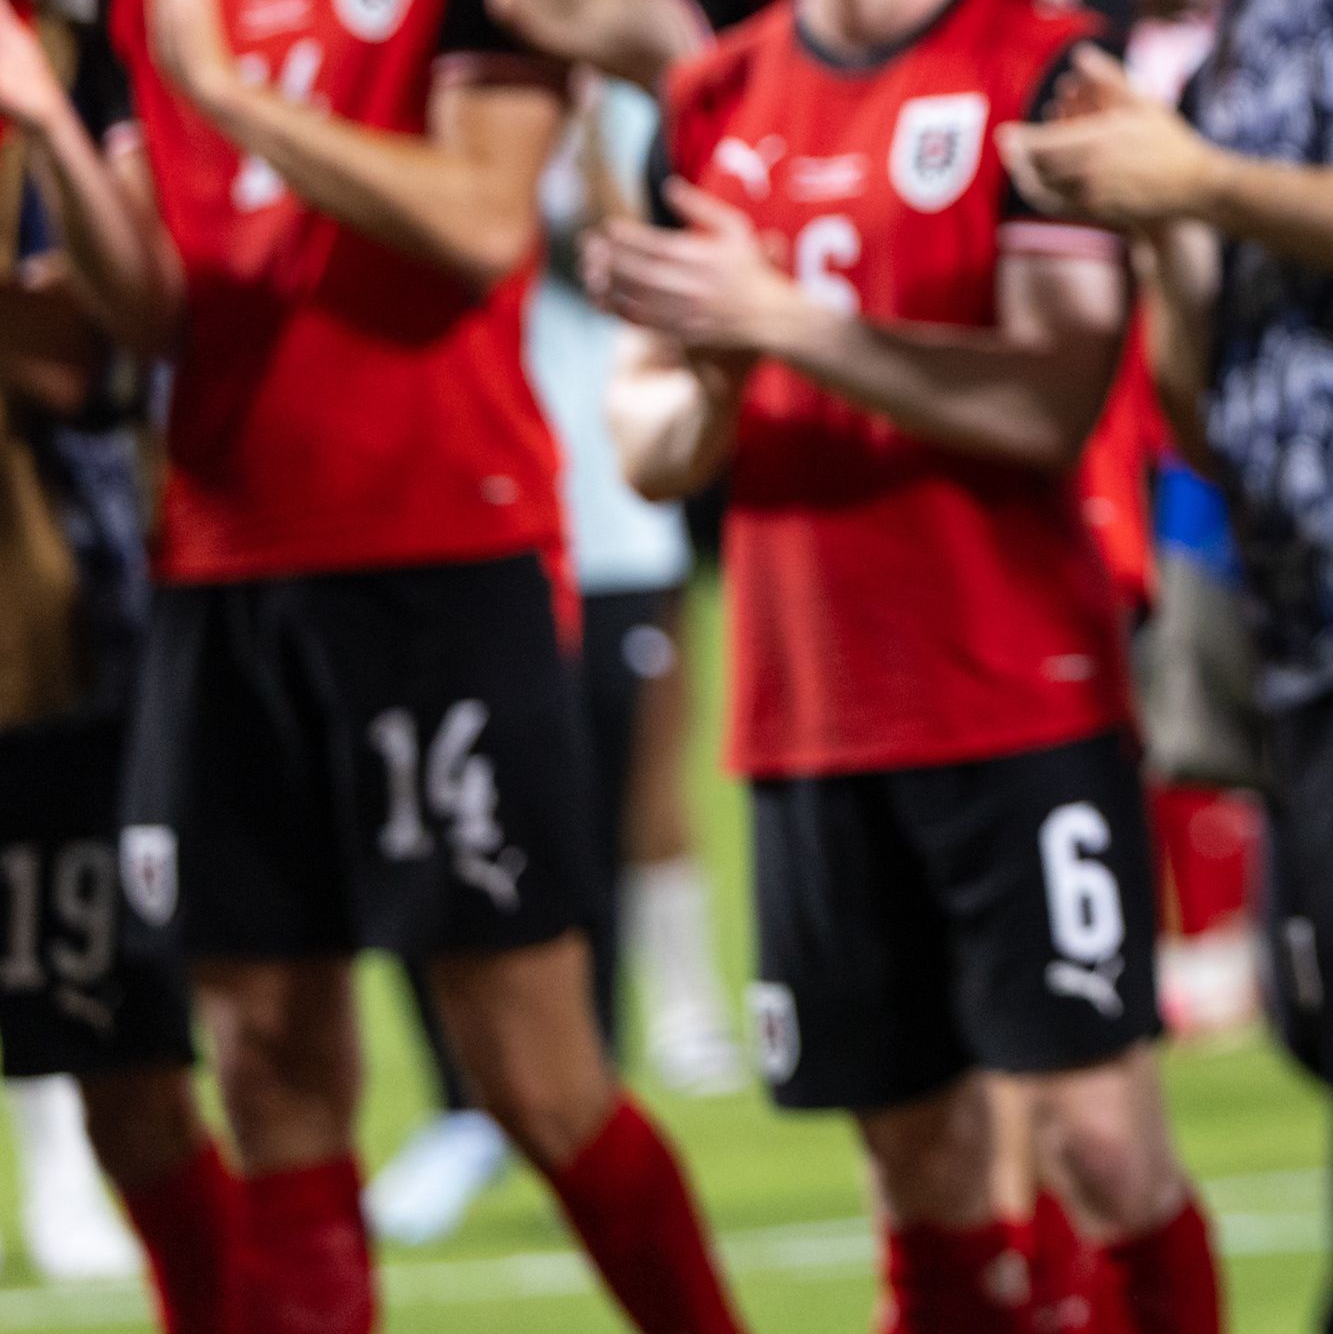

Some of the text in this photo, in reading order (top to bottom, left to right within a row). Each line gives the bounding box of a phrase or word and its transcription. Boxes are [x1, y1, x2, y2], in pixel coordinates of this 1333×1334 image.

[368, 698, 505, 861] 14
[0, 840, 118, 992] 19
[1040, 800, 1125, 962] 6
